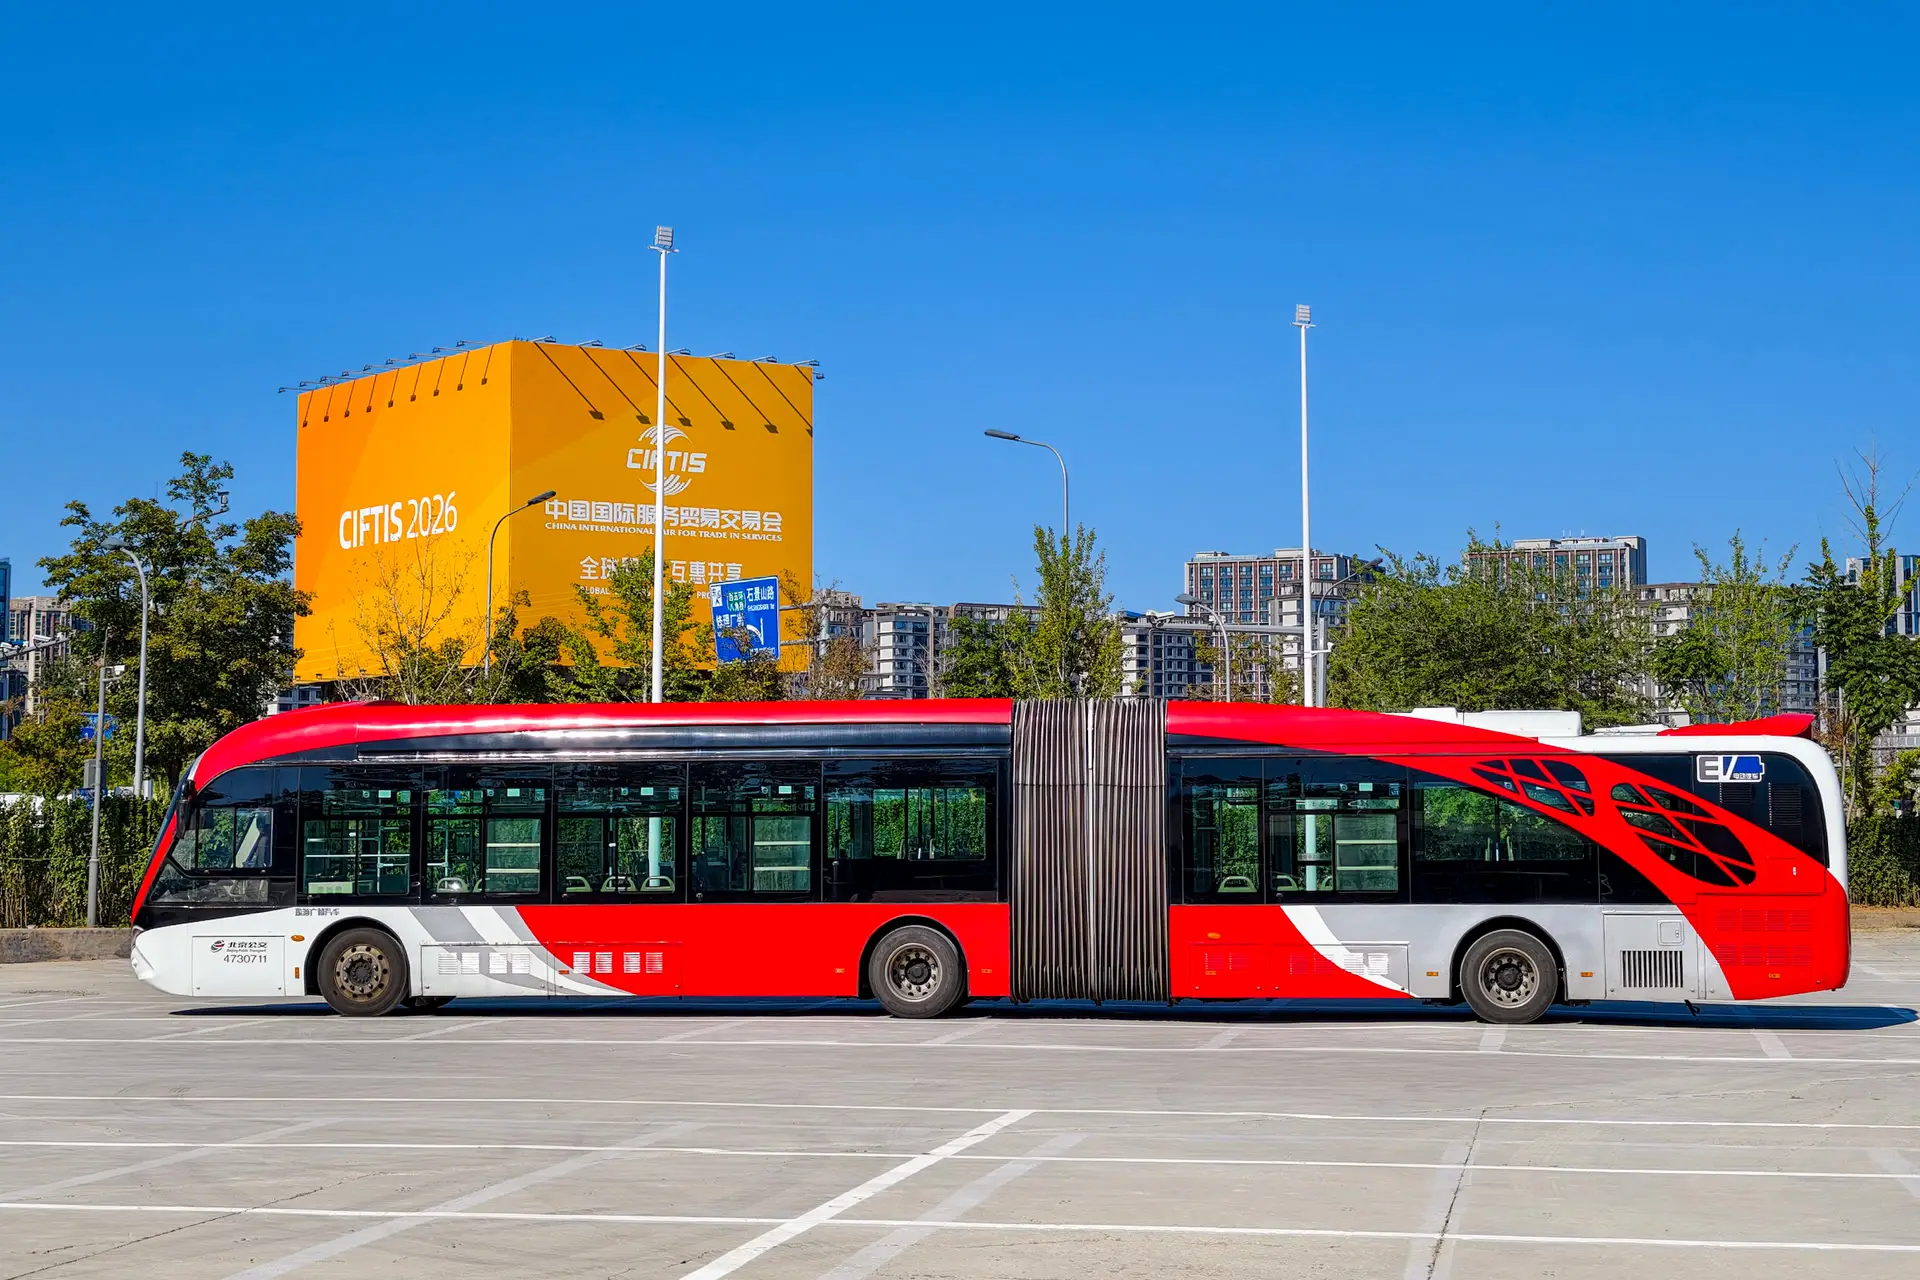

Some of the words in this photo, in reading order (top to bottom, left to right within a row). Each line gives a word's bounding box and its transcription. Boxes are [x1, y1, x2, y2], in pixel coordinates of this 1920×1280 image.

[339, 501, 403, 550] CIFTIS
[406, 491, 458, 539] 2026
[545, 522, 577, 531] CHINA
[579, 523, 654, 535] INTERNATIONAL
[661, 528, 676, 536] AIR
[678, 529, 696, 537] FOR
[699, 530, 727, 539] TRADE
[730, 532, 740, 540] IN
[742, 532, 782, 542] SERVICES
[670, 560, 742, 584] 互惠共享
[1699, 756, 1738, 780] EV
[228, 941, 268, 949] 北京公交
[223, 954, 267, 963] 4730711
